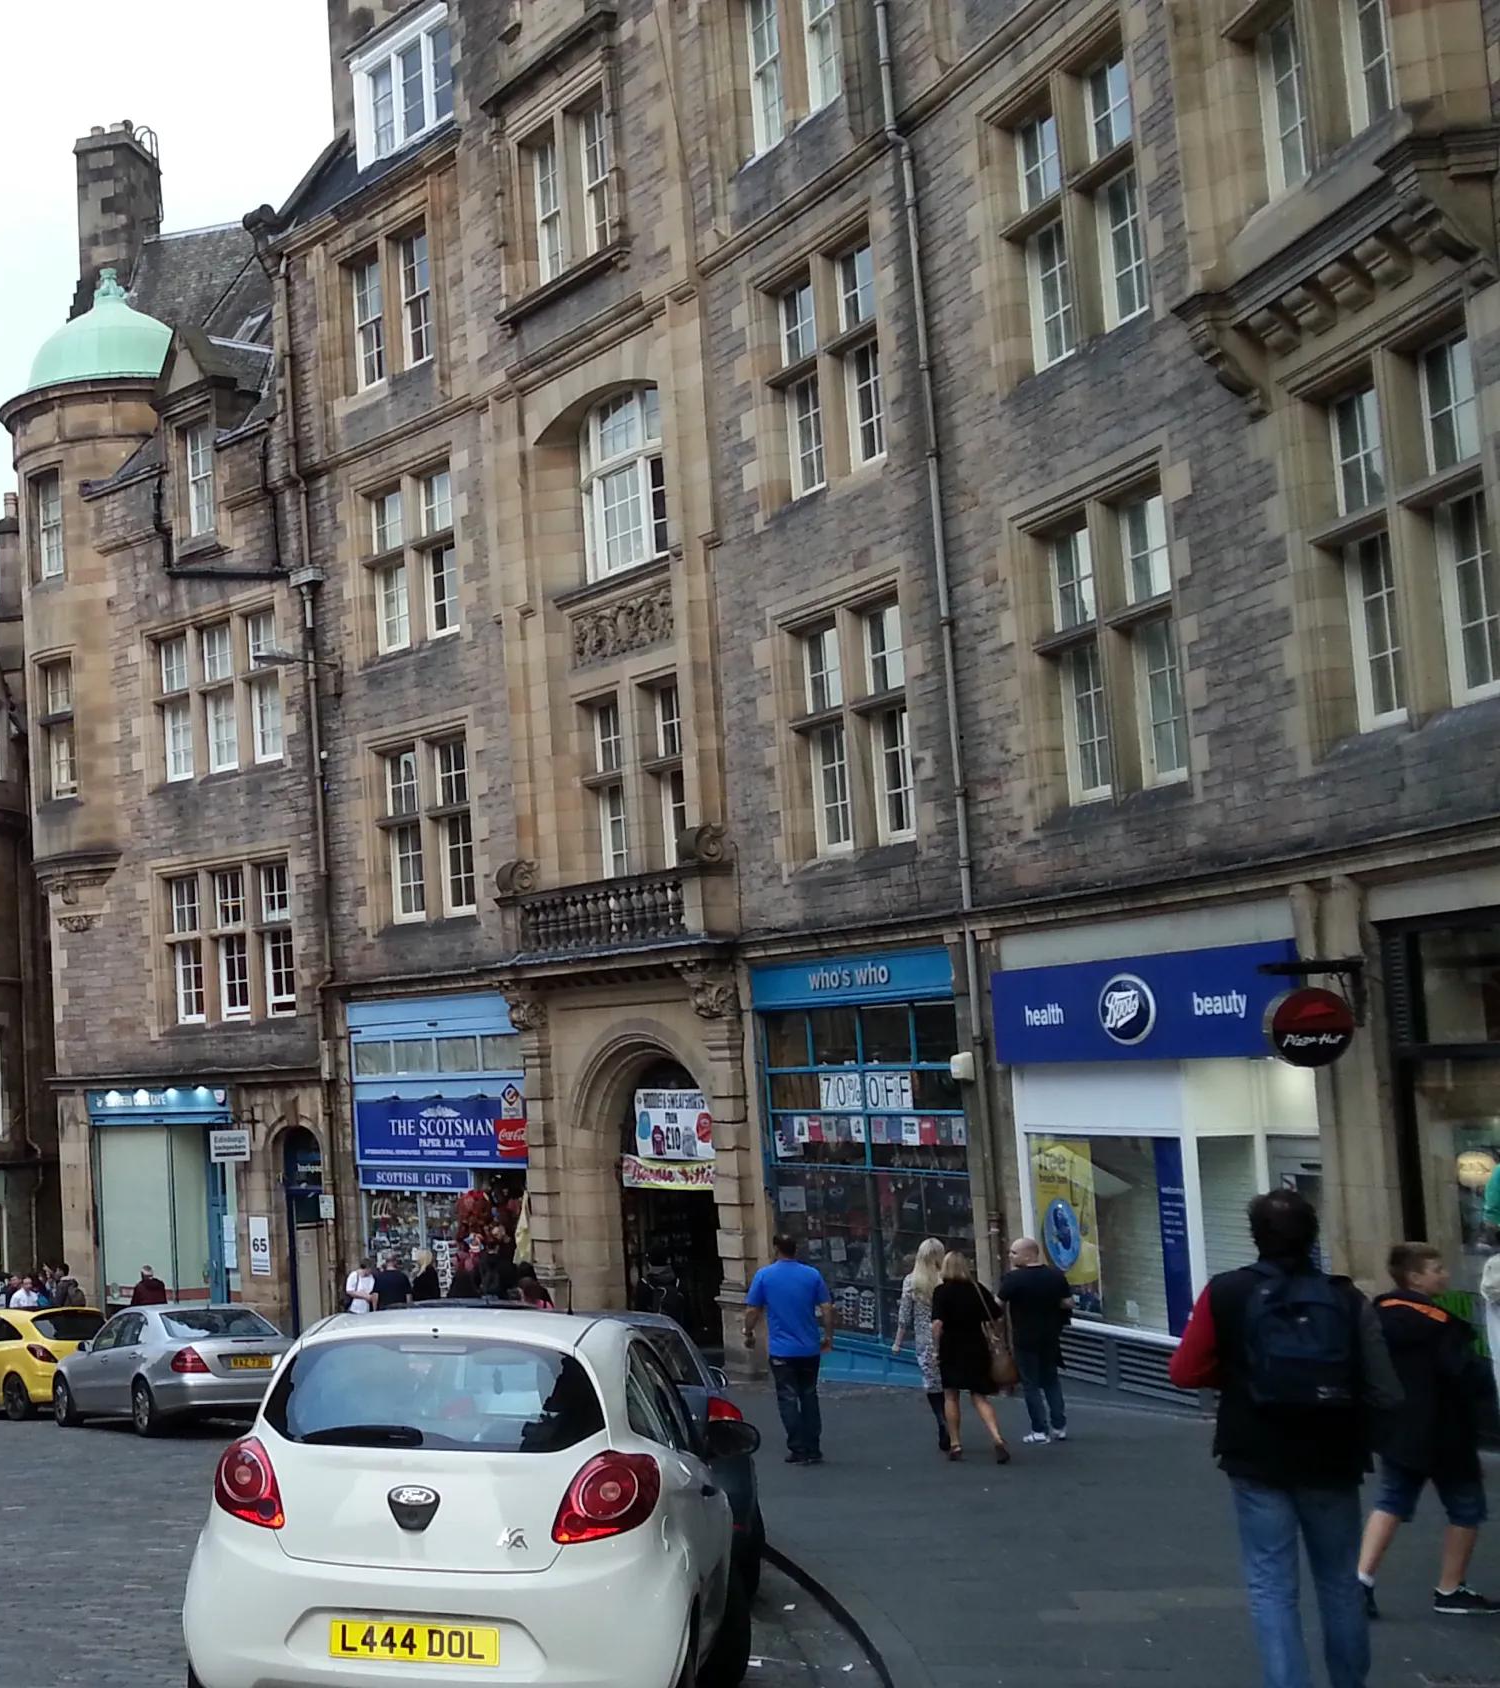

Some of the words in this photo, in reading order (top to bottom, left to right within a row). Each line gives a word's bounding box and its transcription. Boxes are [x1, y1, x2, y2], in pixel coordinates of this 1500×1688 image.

[808, 967, 852, 992] who's
[855, 961, 889, 986] who
[1104, 990, 1140, 1029] Boots
[1192, 989, 1247, 1019] beauty
[1024, 1003, 1065, 1028] health
[1282, 1033, 1317, 1048] Pizza
[1318, 1032, 1346, 1045] Hut
[823, 1076, 862, 1107] 70%
[868, 1075, 910, 1107] OFF
[388, 1119, 416, 1136] THE
[419, 1118, 495, 1137] SCOTSMAN
[213, 1135, 246, 1144] Edinburgh
[418, 1138, 441, 1148] PAPER
[376, 1172, 419, 1184] SCOTTISH
[424, 1173, 453, 1185] GIFTS
[252, 1237, 268, 1253] 65
[399, 1489, 427, 1504] Ford
[341, 1624, 417, 1656] L444
[427, 1628, 486, 1660] DOL
